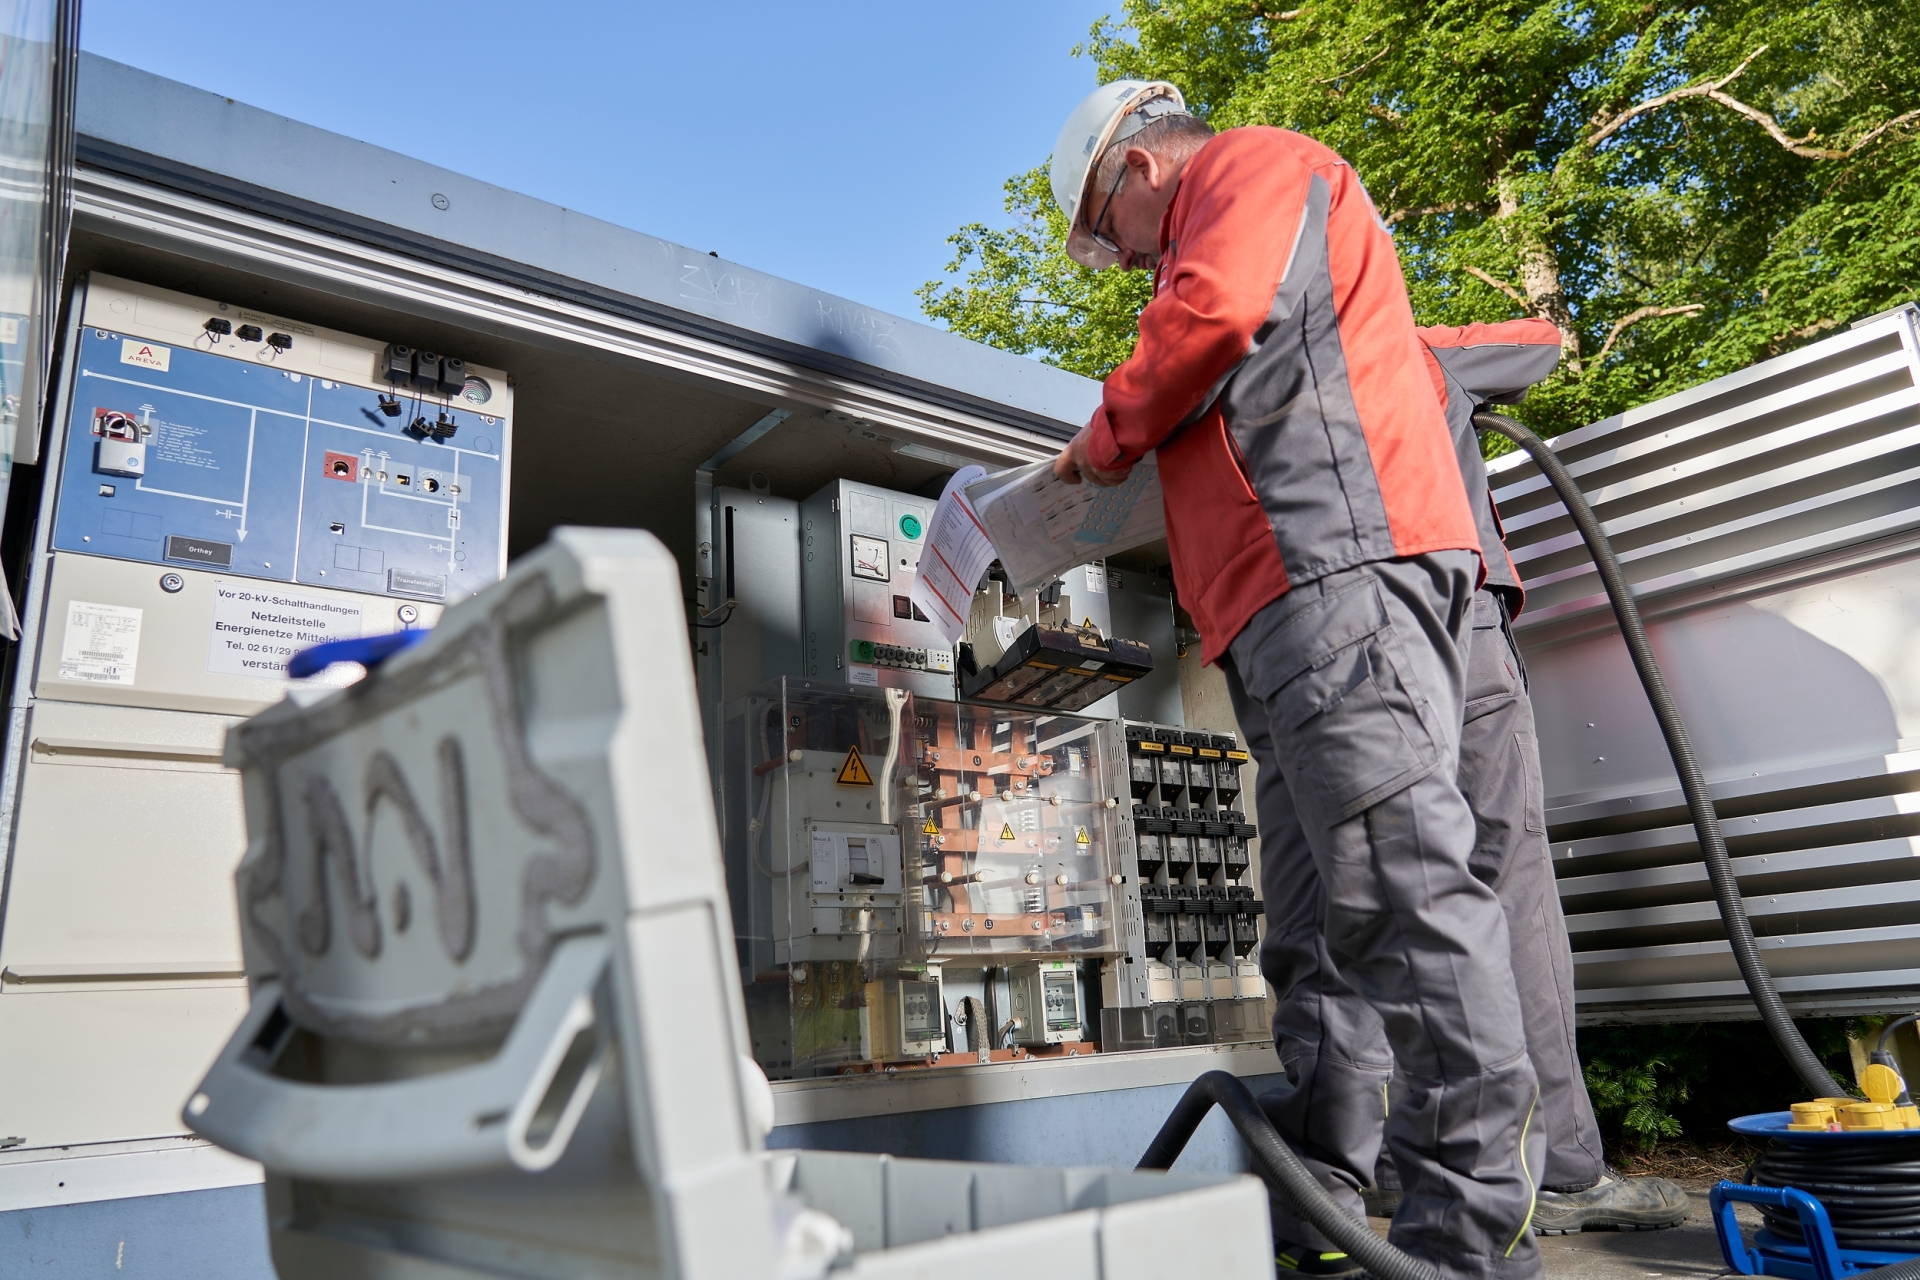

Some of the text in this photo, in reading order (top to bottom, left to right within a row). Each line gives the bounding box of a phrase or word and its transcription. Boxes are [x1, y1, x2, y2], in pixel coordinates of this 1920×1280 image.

[128, 355, 162, 367] AREVA
[188, 546, 213, 556] Orthey
[396, 576, 441, 588] Transformator
[218, 589, 360, 616] Vor 20-kV-Schalthandlungen
[251, 611, 326, 629] Netzleitstelle
[215, 621, 293, 639] Energienetze
[226, 640, 244, 650] Tel.
[247, 643, 260, 652] 02
[262, 645, 291, 656] 61/29
[242, 659, 289, 671] verstän
[791, 718, 800, 726] L3
[829, 974, 838, 983] L2
